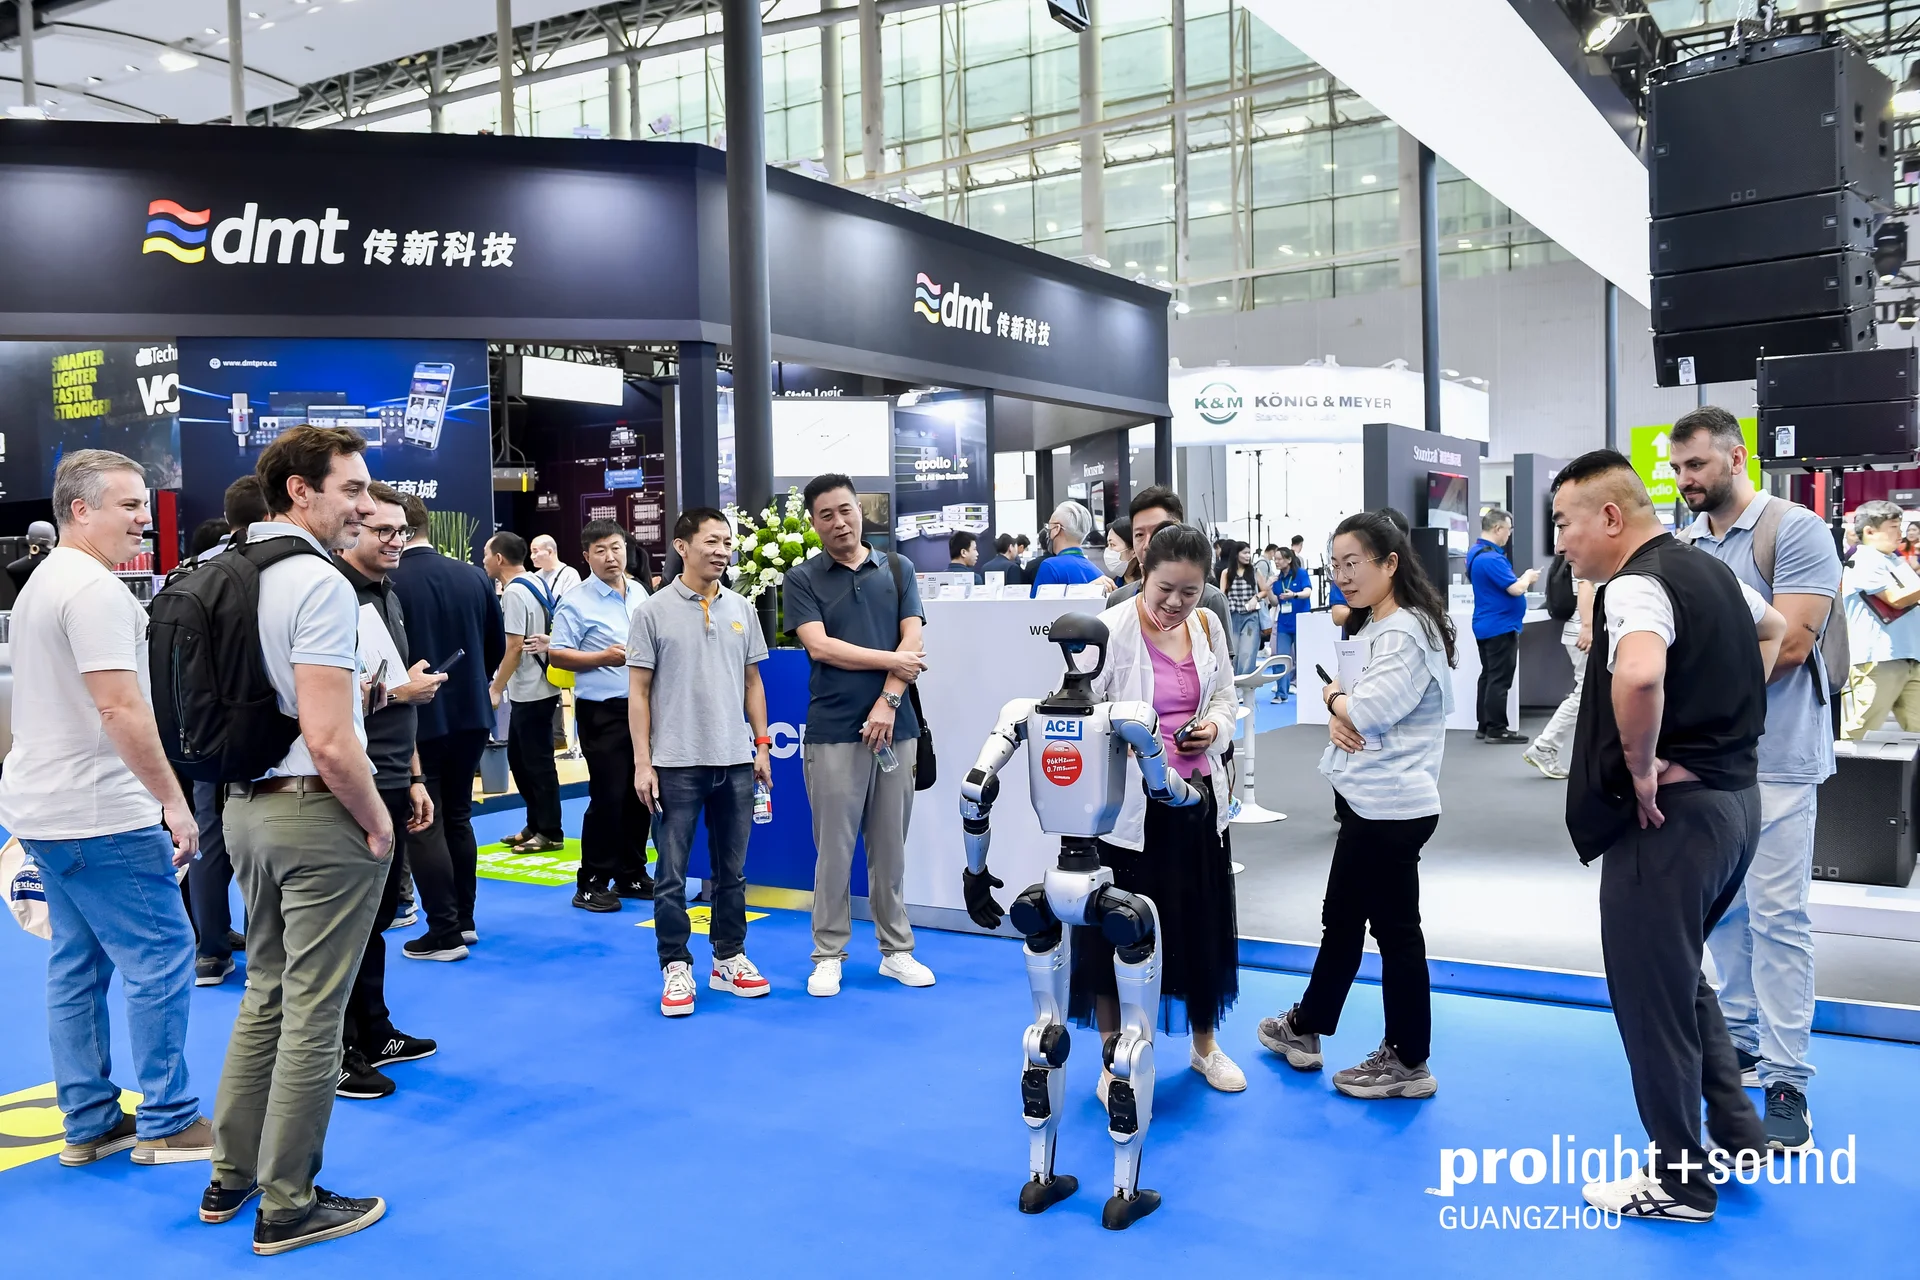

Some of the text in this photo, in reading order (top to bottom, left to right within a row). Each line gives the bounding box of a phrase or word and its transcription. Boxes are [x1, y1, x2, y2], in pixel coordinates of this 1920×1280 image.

[210, 202, 517, 267] dmt 传新科技
[941, 282, 1051, 346] dmt 传新科技
[52, 350, 104, 372] SMARTER
[222, 360, 278, 368] www.dmtpro.cc
[52, 367, 97, 388] LIGHTER
[53, 385, 93, 404] FASTER
[1255, 392, 1392, 409] KÖNIG & MEYER
[915, 457, 951, 472] apollo
[1646, 483, 1673, 497] udio
[1029, 622, 1054, 636] we
[1045, 720, 1075, 732] ACE
[1046, 757, 1067, 765] 96kHz
[1046, 765, 1066, 773] 0.7ms
